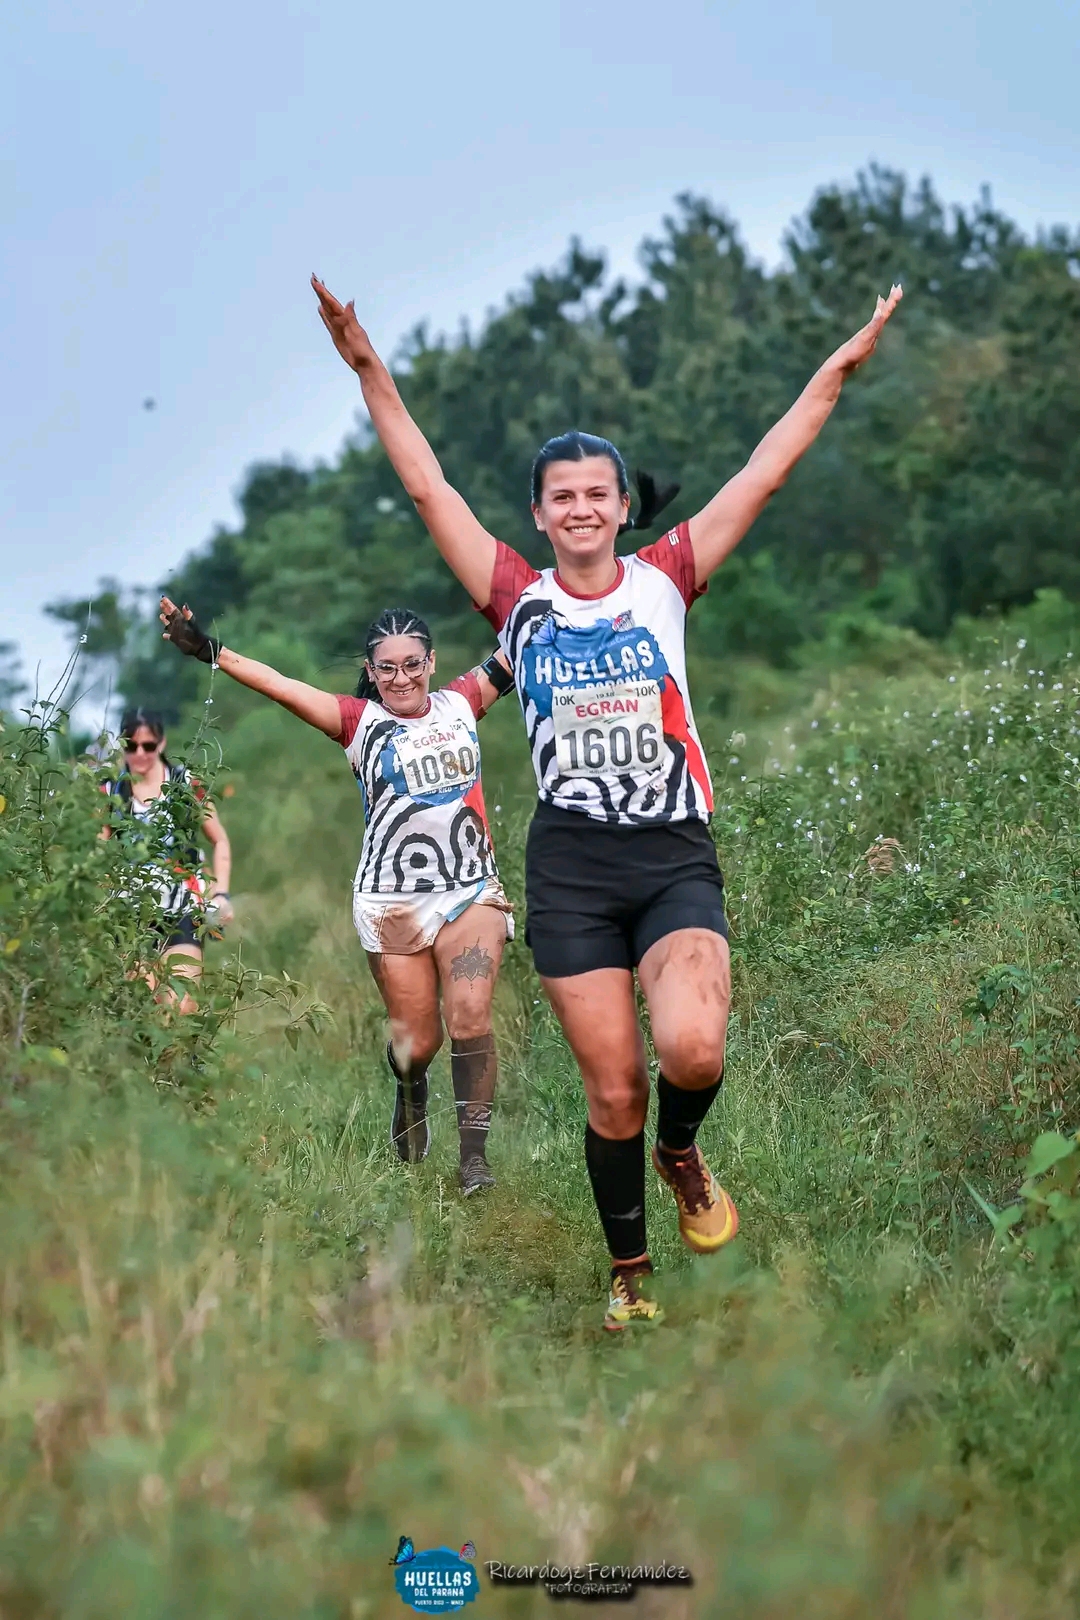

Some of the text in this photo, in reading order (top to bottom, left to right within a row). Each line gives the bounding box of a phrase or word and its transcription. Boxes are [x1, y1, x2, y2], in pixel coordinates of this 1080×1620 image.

[535, 640, 655, 684] HUELLAS
[554, 694, 575, 706] 10K
[635, 685, 657, 697] 10K
[575, 699, 639, 718] EGRAN
[395, 735, 412, 745] 10K
[412, 731, 456, 749] EGRAN
[562, 723, 659, 770] 1606
[406, 746, 475, 788] 1080
